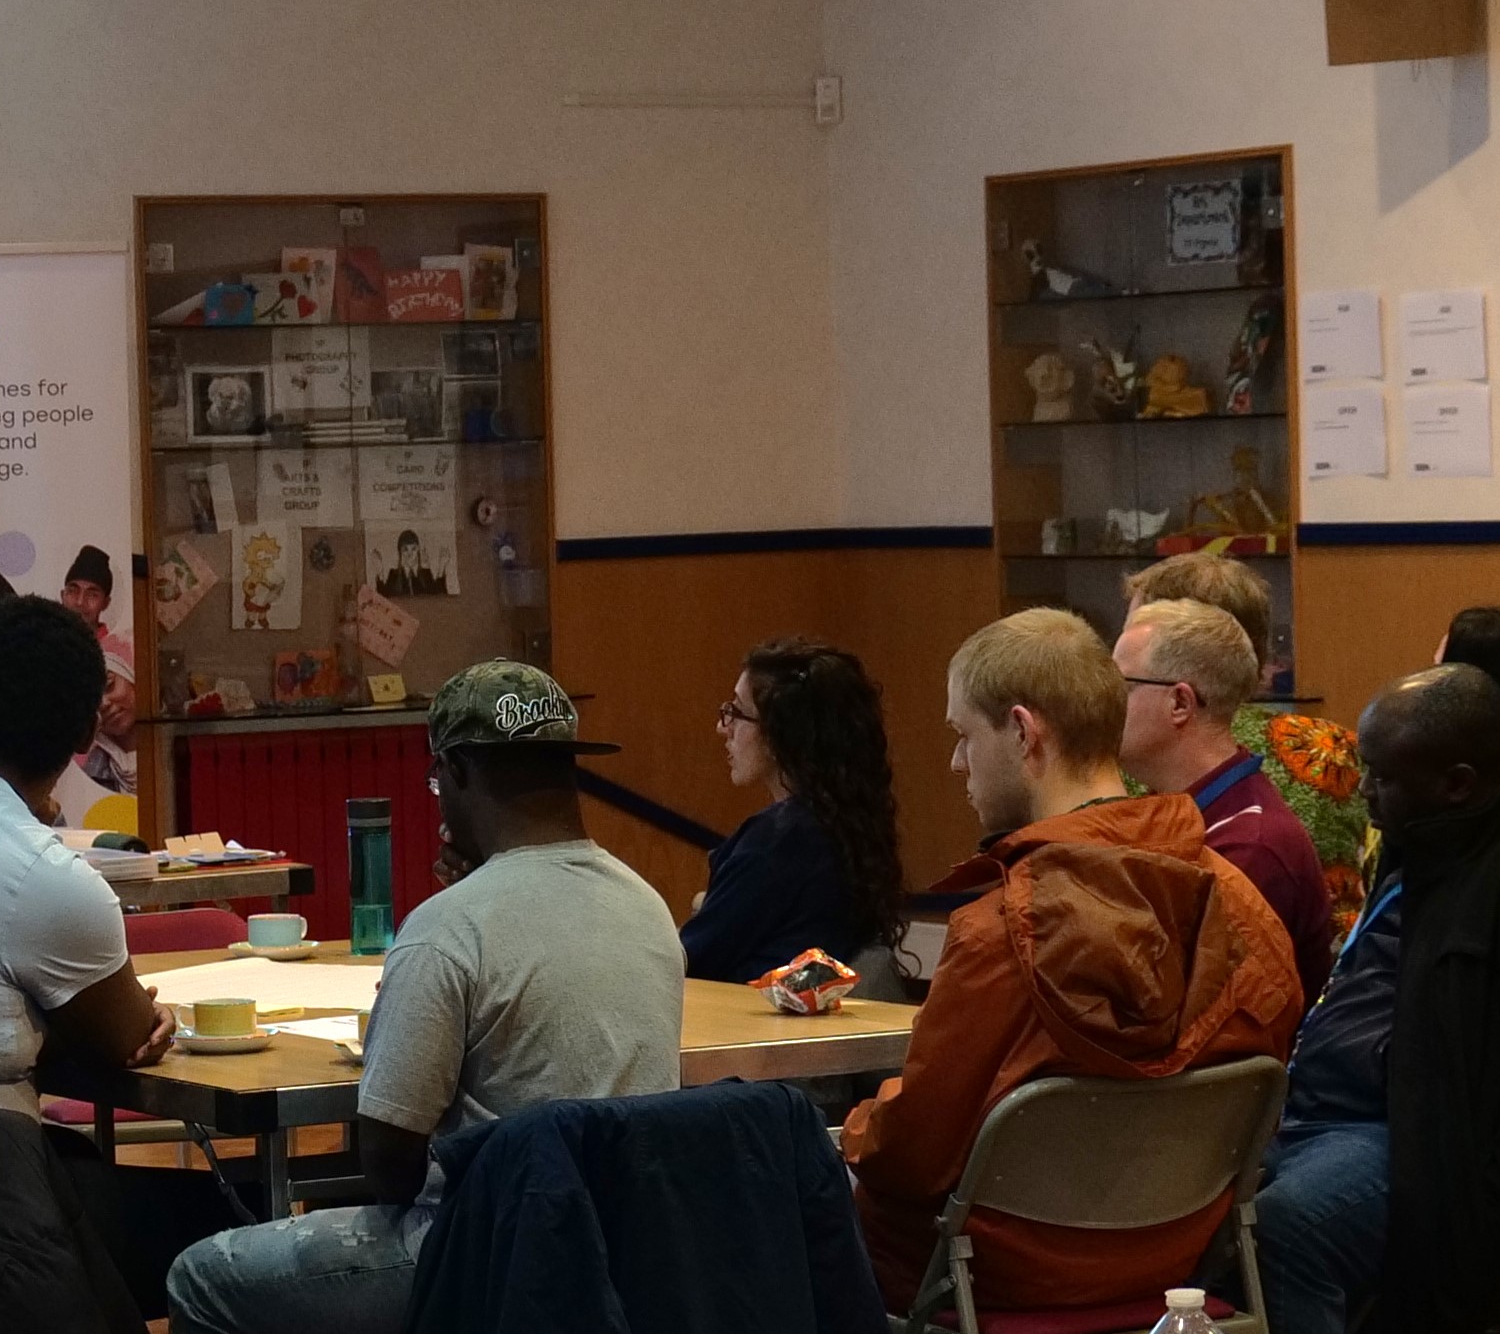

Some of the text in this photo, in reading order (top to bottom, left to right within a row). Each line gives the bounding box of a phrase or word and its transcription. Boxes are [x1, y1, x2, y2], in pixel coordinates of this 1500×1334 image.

[387, 271, 448, 288] HAPPY
[37, 378, 68, 397] for
[22, 404, 94, 428] people
[284, 500, 322, 510] GROUP
